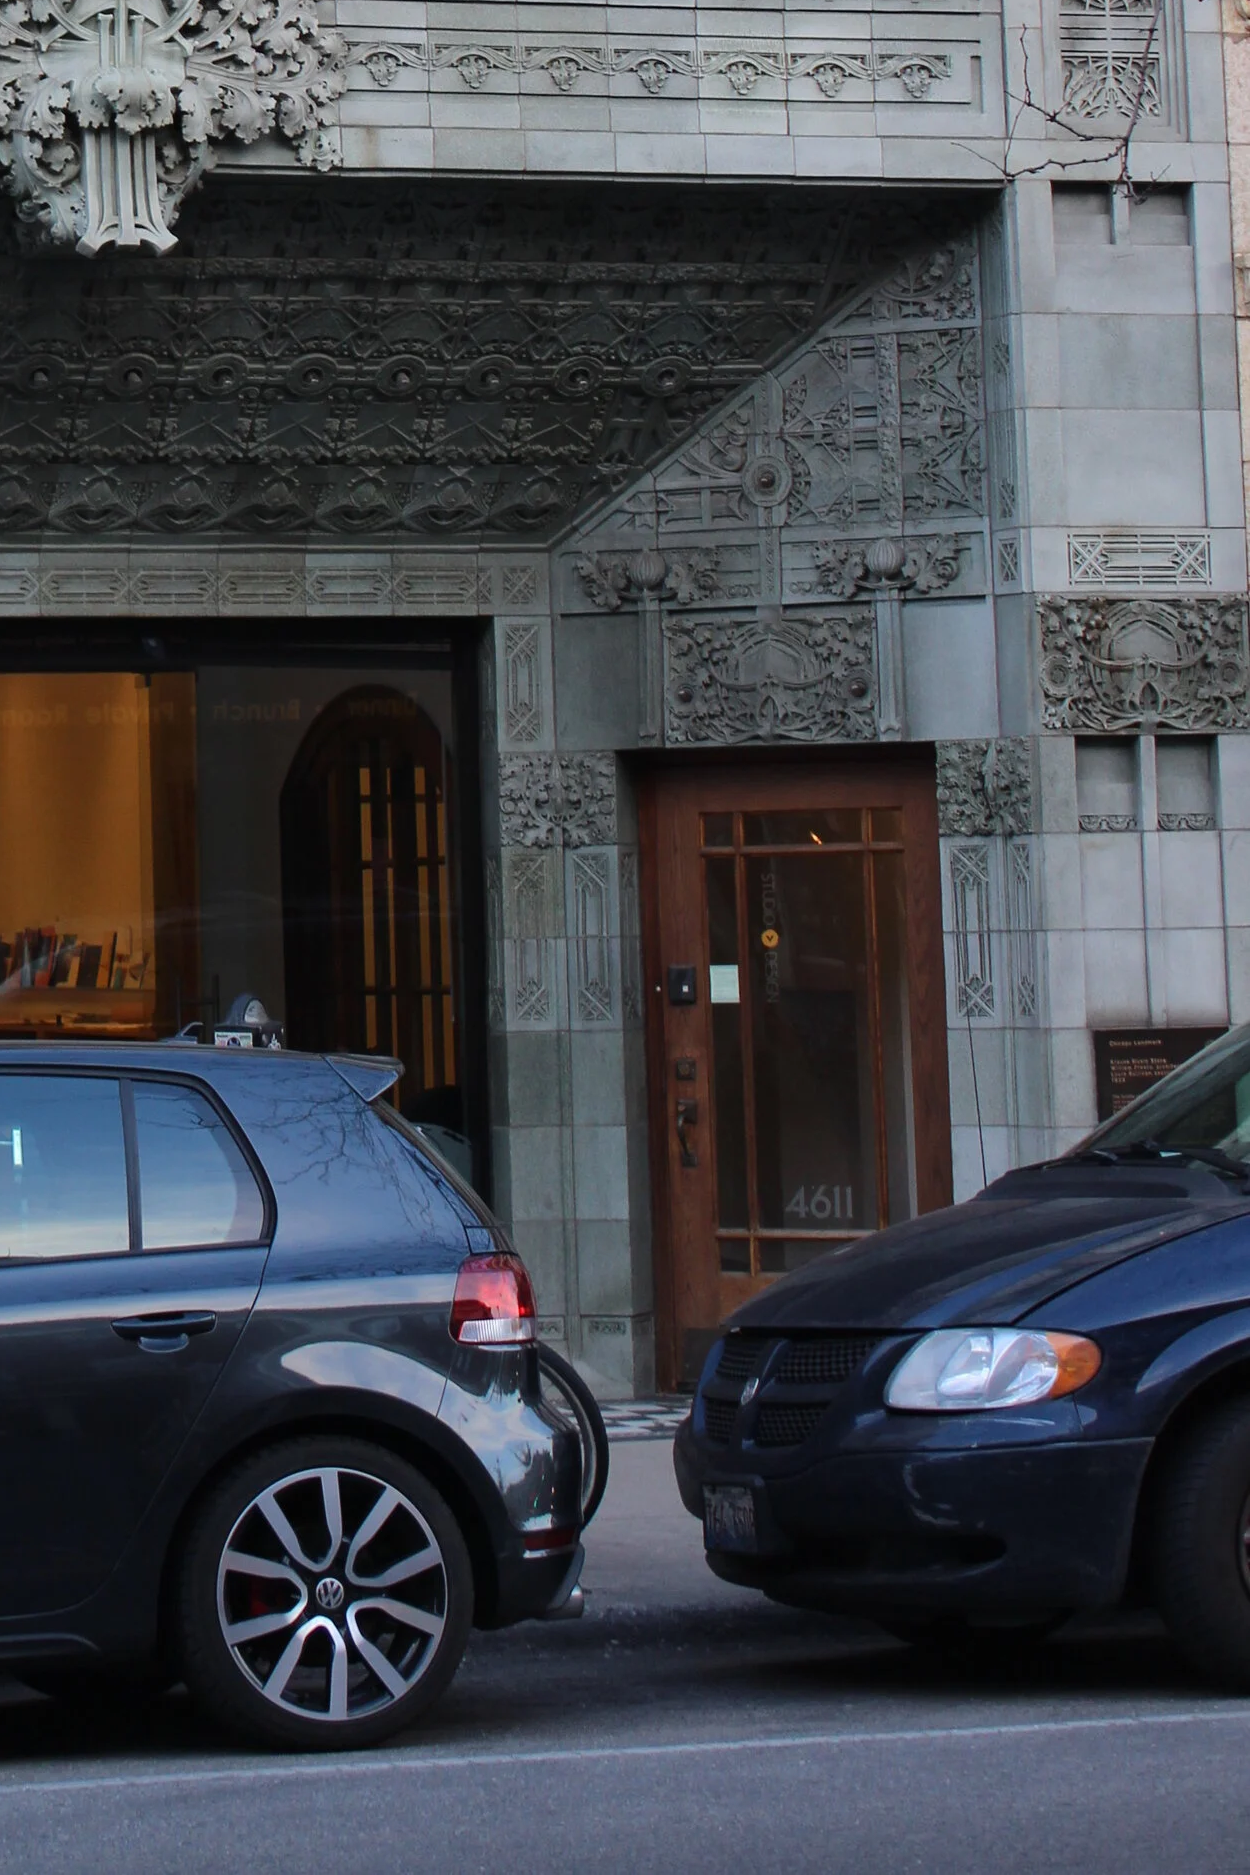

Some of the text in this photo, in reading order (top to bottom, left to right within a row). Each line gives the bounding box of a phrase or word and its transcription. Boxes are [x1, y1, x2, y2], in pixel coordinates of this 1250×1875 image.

[760, 872, 776, 926] STUDIO
[764, 951, 779, 1003] DESIGN
[1109, 1040, 1133, 1048] Chicago
[785, 1184, 854, 1220] 4611
